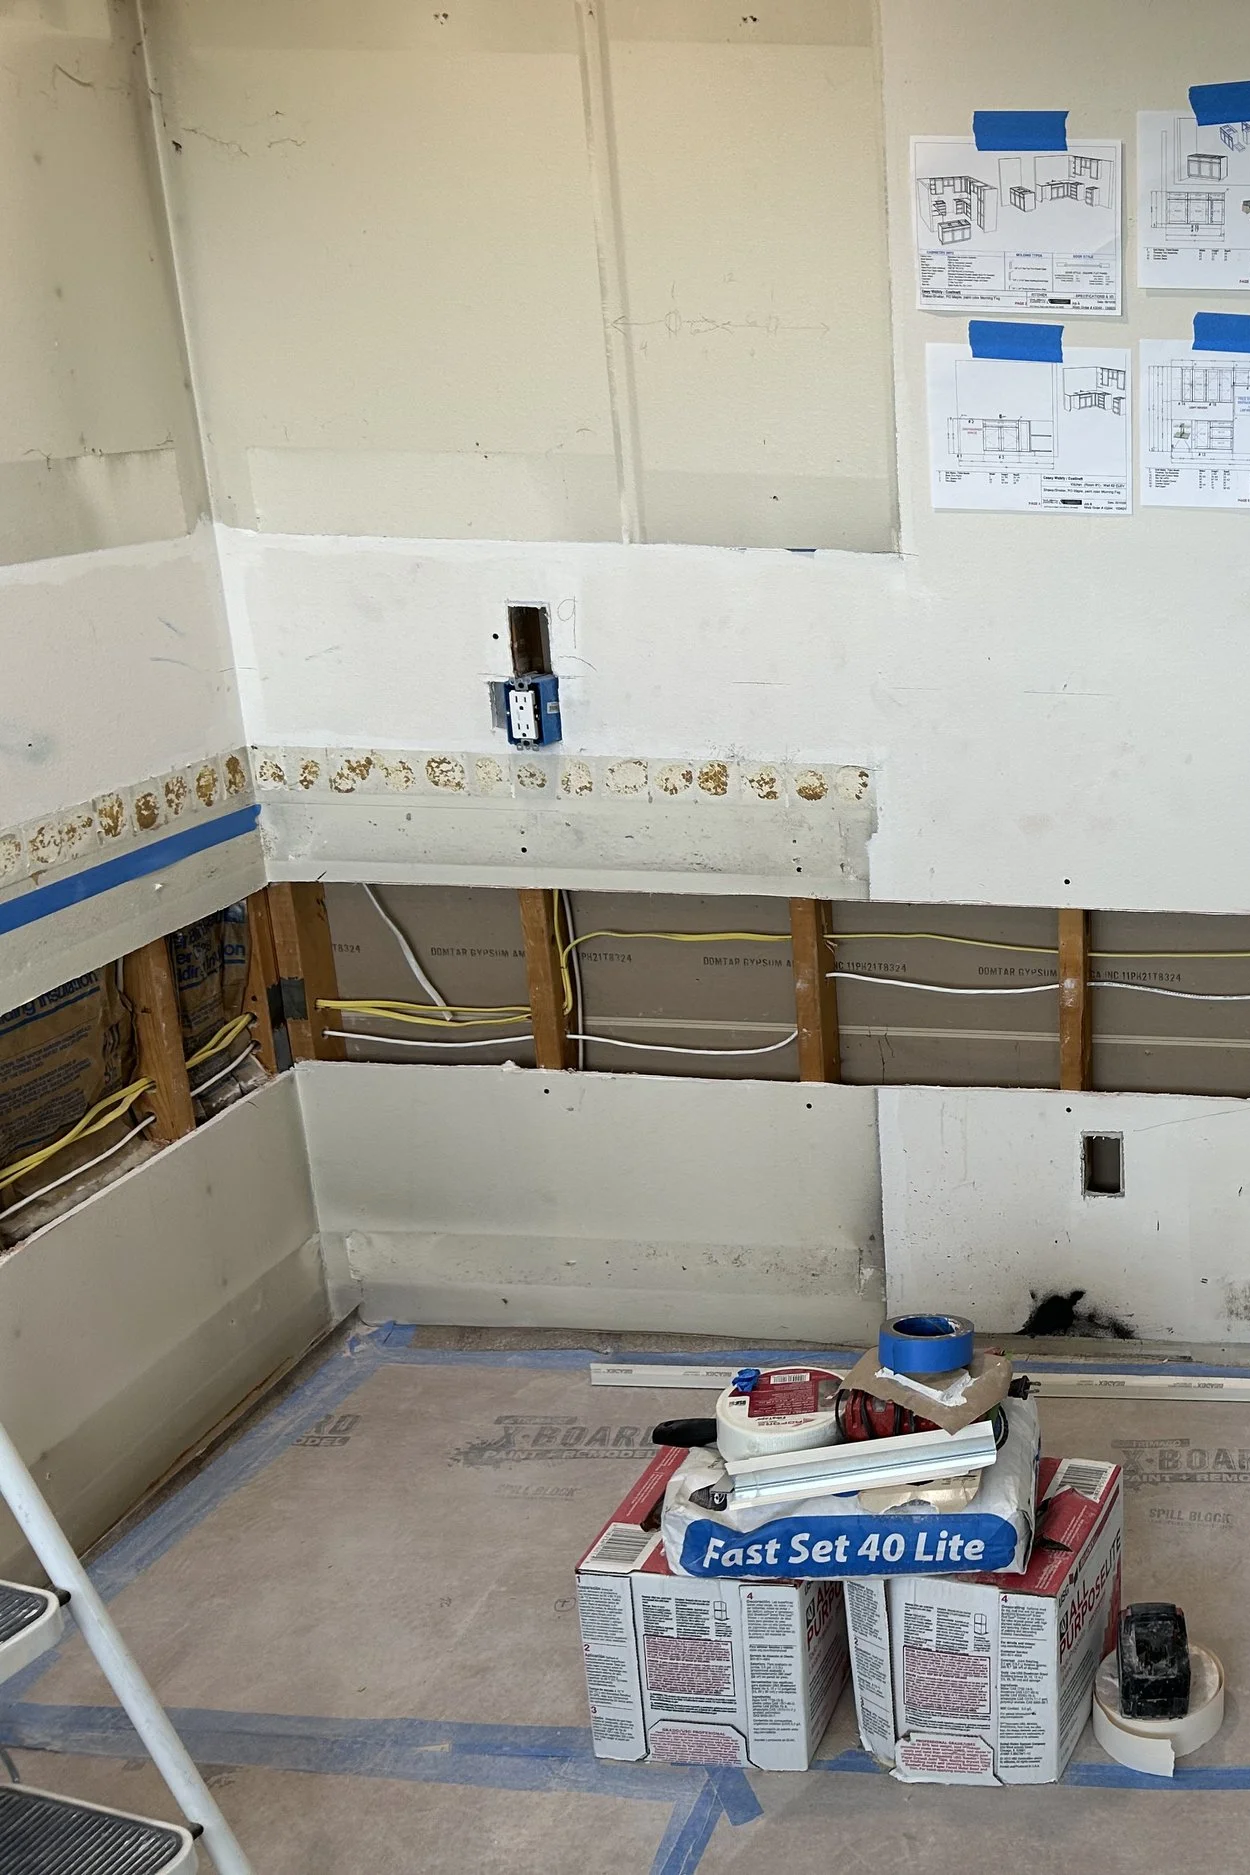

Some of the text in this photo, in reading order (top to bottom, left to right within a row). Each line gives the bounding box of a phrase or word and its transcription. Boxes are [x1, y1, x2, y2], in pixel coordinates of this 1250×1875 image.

[430, 947, 510, 960] DOMTAR GYPSUM
[703, 956, 783, 968] DOMTAR GYPSUM
[978, 966, 1058, 978] DOMTAR GYPSUM
[1104, 970, 1120, 981] INC
[1123, 1473, 1174, 1483] PAINT
[1149, 1508, 1233, 1524] SPILL BLOCK
[702, 1529, 985, 1569] Fast Set 40 Lite
[746, 1591, 753, 1600] 4
[1001, 1594, 1008, 1603] 4
[1068, 1578, 1089, 1617] ALL
[583, 1643, 590, 1652] 2
[591, 1705, 598, 1714] 3
